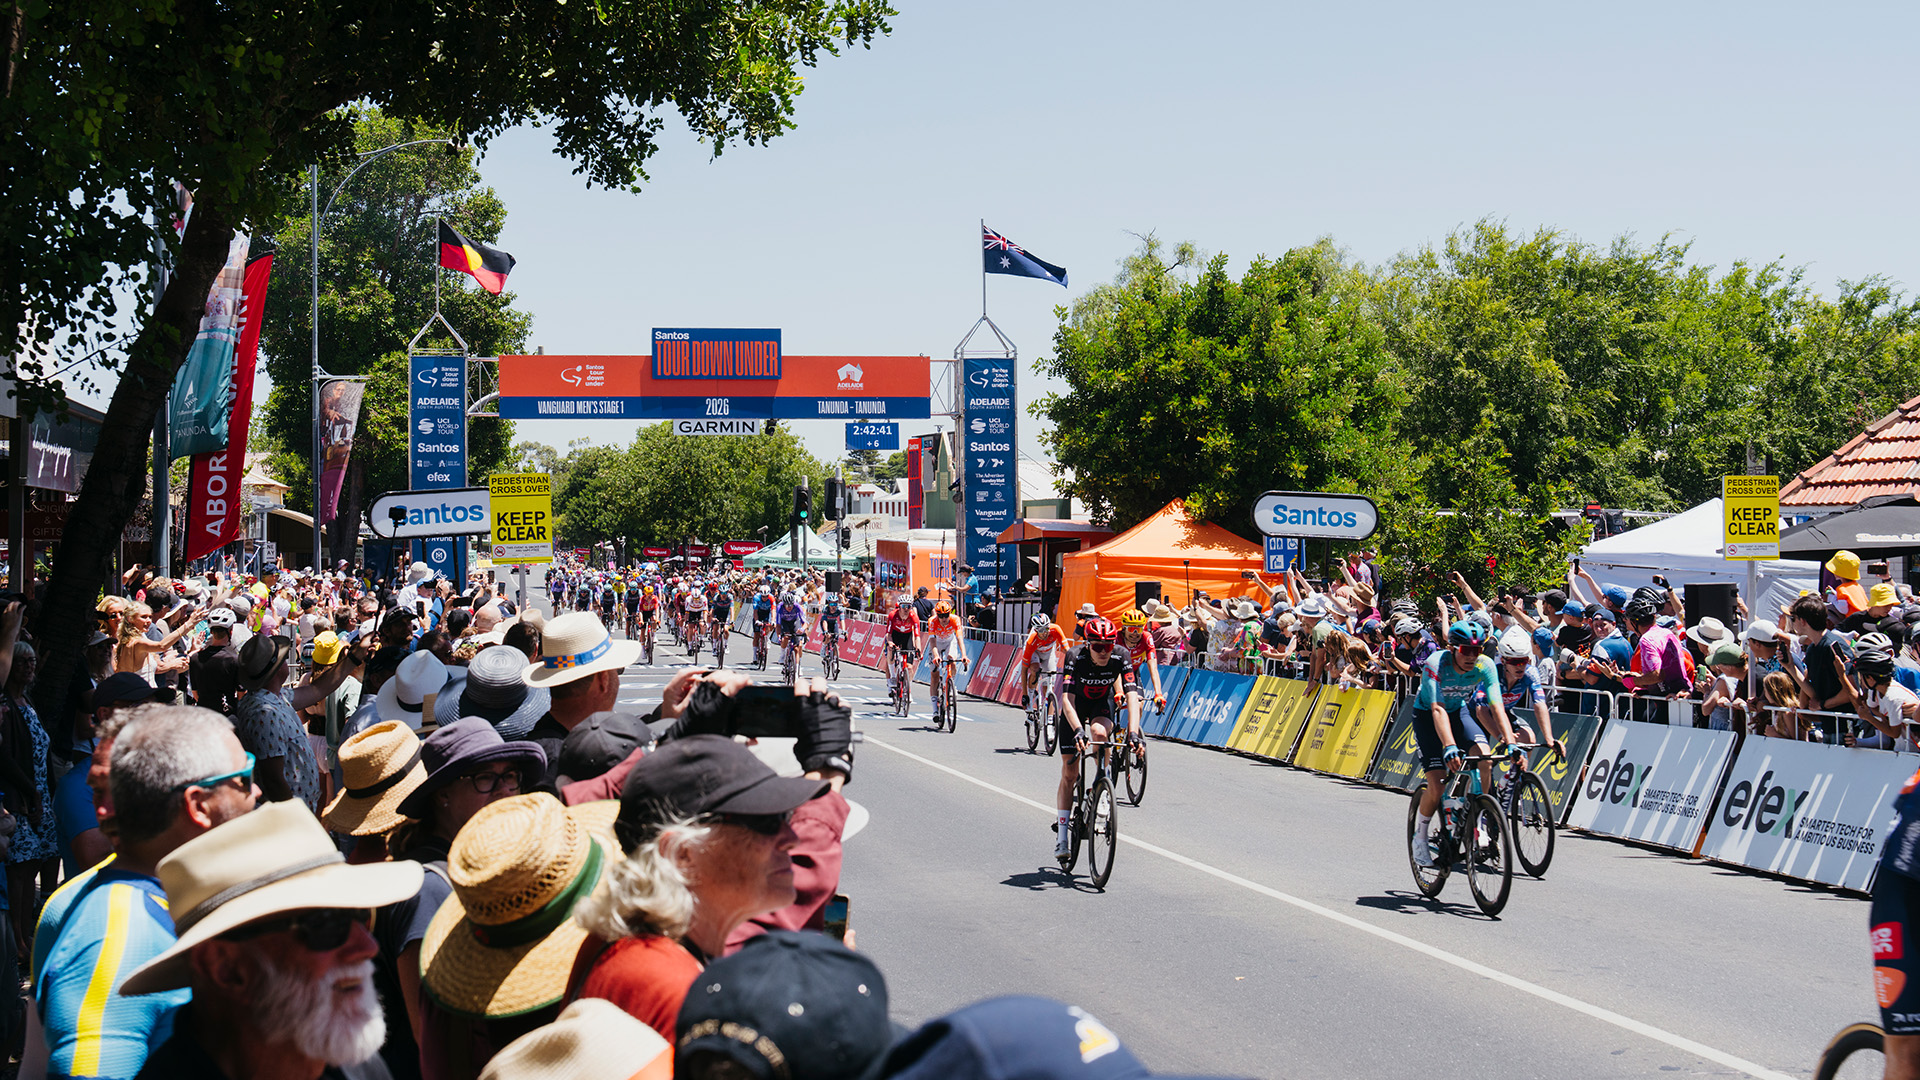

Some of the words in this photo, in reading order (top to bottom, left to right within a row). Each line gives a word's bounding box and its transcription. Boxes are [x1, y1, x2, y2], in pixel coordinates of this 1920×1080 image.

[654, 331, 690, 340] Santos
[655, 340, 690, 376] TOUR
[692, 340, 734, 376] DOWN
[735, 341, 779, 376] UNDER
[538, 400, 575, 414] VANGUARD
[576, 400, 598, 414] MEN'S
[599, 400, 619, 414] STAGE
[620, 401, 624, 414] 1
[705, 398, 730, 415] 2026
[817, 401, 849, 414] TANUNDA
[855, 401, 886, 414] TANUNDA
[678, 421, 755, 433] GARMIN
[853, 425, 892, 435] 2:42:41
[418, 442, 460, 453] Santos
[970, 442, 1010, 452] Santos
[427, 472, 450, 482] efex
[492, 476, 549, 485] PEDESTRIAN
[490, 486, 522, 494] CROSS
[525, 484, 550, 493] OVER
[497, 511, 545, 526] KEEP
[975, 509, 1007, 517] Vanguard
[1272, 504, 1357, 528] Santos
[1732, 508, 1772, 520] KEEP
[32, 528, 64, 536] GIFTS
[497, 526, 547, 541] CLEAR
[1728, 522, 1776, 535] CLEAR
[1183, 690, 1232, 724] Santos
[1378, 758, 1412, 776] AUSCYCLING
[1586, 749, 1652, 808] efex
[1644, 788, 1671, 802] SMARTER
[1670, 792, 1686, 804] TECH
[1684, 795, 1699, 805] FOR
[1640, 800, 1669, 814] AMBITIOUS
[1668, 804, 1699, 818] BUSINESS
[1724, 770, 1809, 839] efex
[1800, 816, 1836, 833] SMARTER
[1836, 823, 1857, 836] TECH
[1855, 828, 1874, 840] FOR
[1794, 830, 1838, 848] AMBITIOUS
[1836, 837, 1875, 855] BUSINESS
